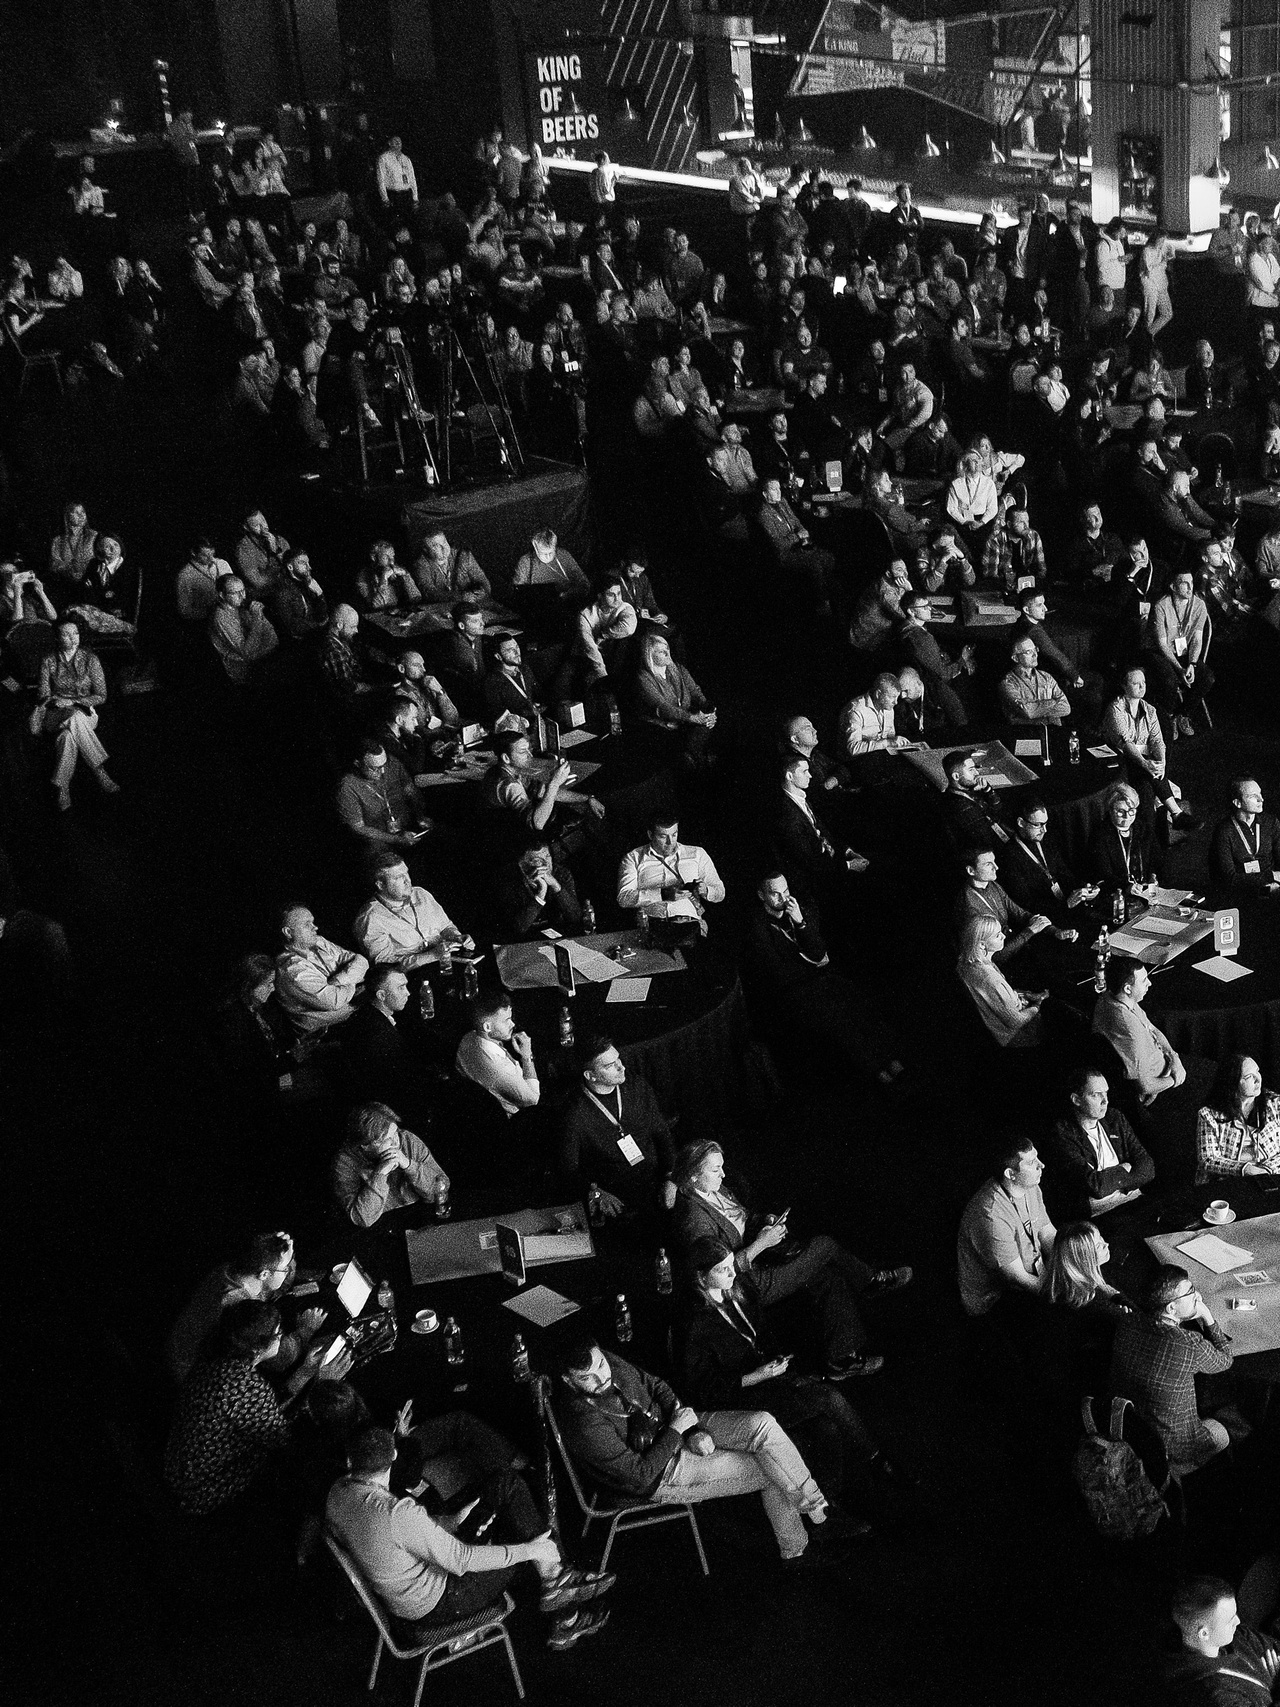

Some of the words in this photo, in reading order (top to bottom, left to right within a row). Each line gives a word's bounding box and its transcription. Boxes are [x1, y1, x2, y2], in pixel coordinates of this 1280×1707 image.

[537, 54, 582, 83] KING
[539, 86, 563, 113] OF
[542, 113, 599, 143] BEERS
